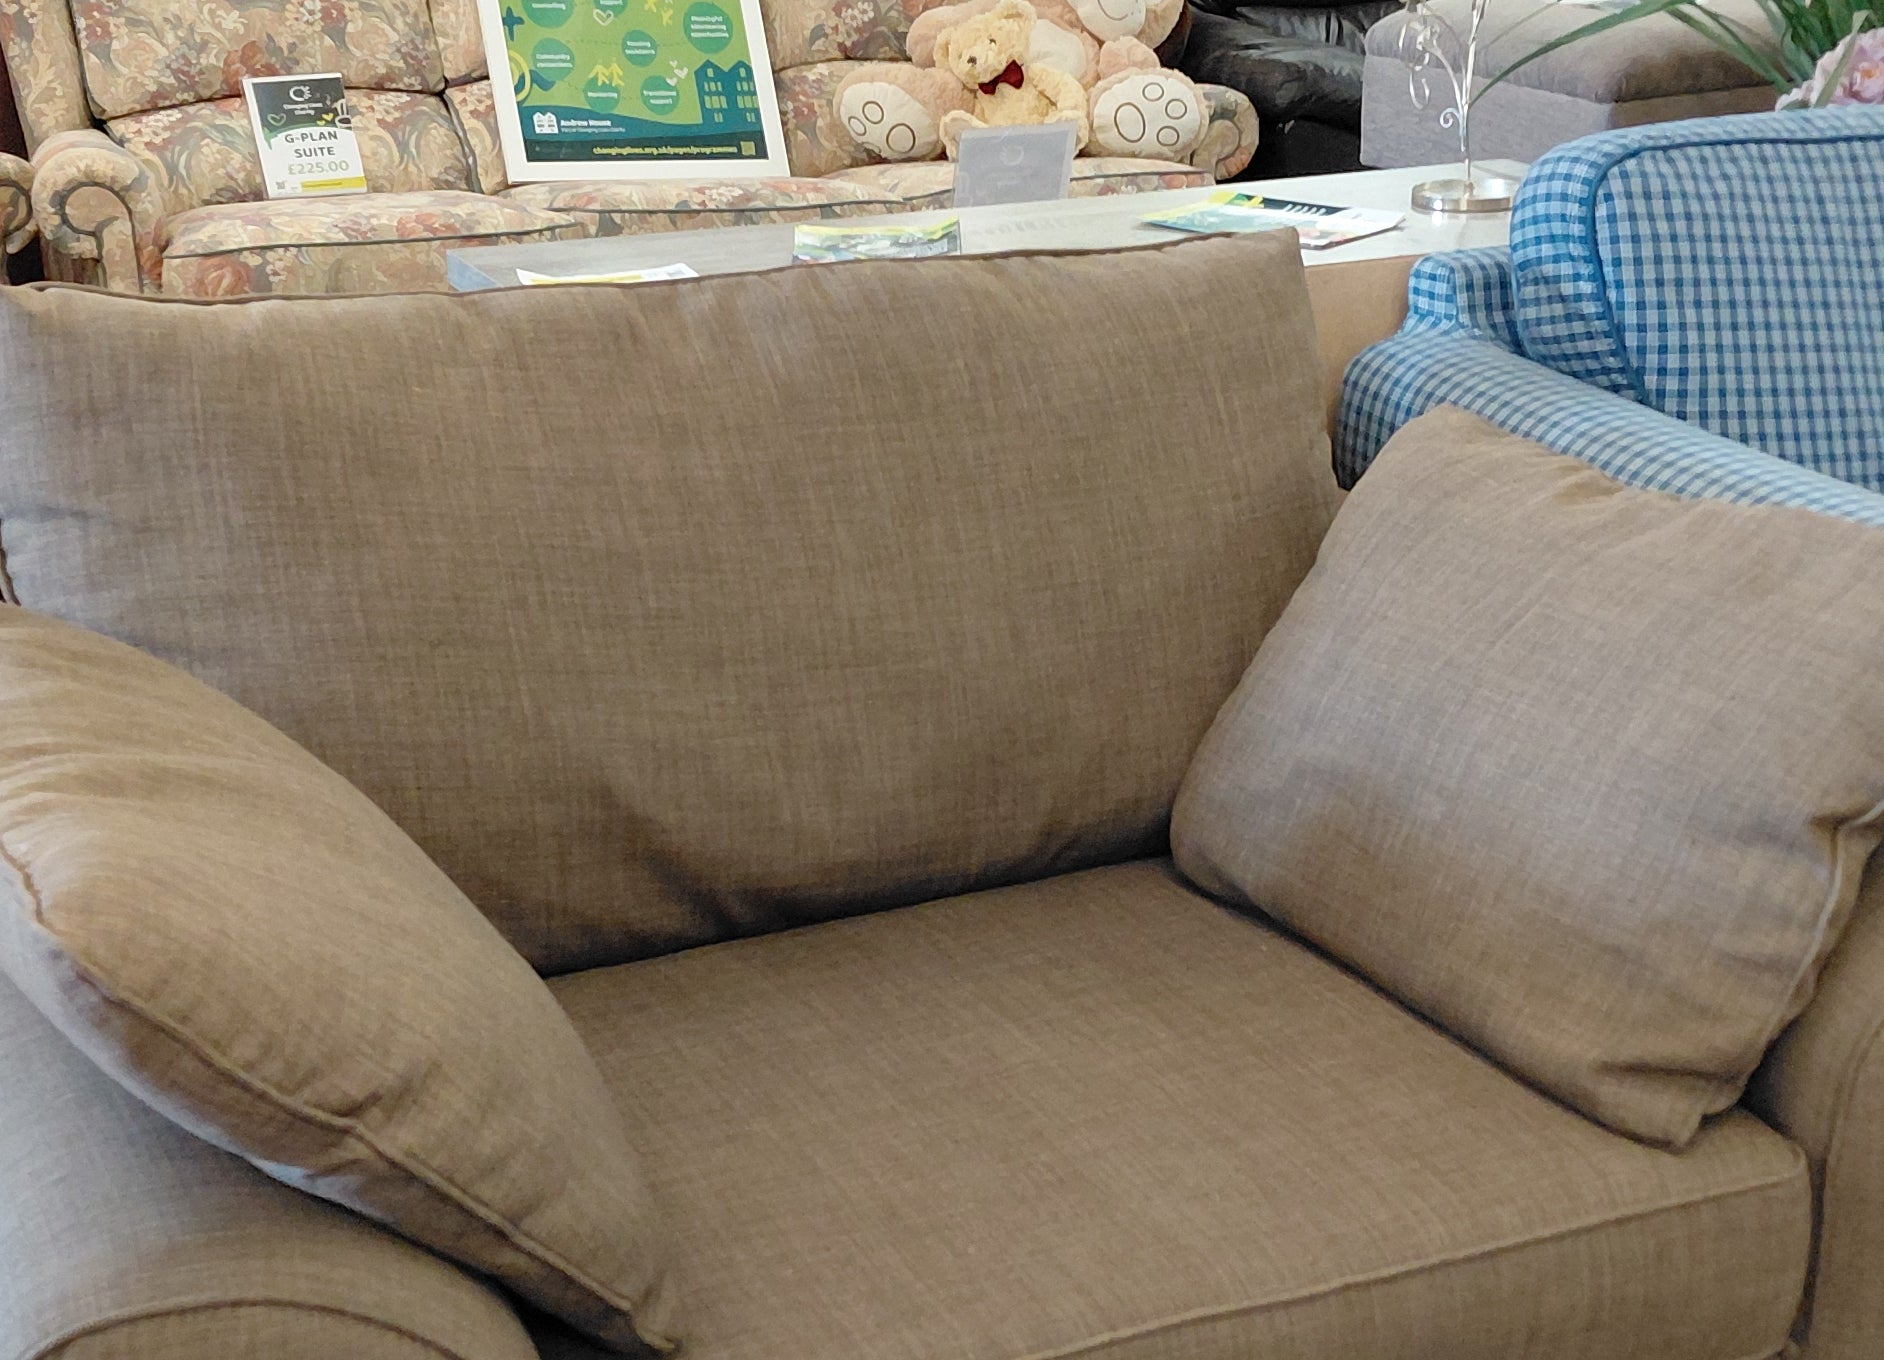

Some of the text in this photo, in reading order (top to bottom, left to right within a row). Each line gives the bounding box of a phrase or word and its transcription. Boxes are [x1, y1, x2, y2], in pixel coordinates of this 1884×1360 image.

[284, 130, 339, 144] G-PLAN
[294, 146, 336, 159] SUITE
[287, 159, 350, 176] £225.00
